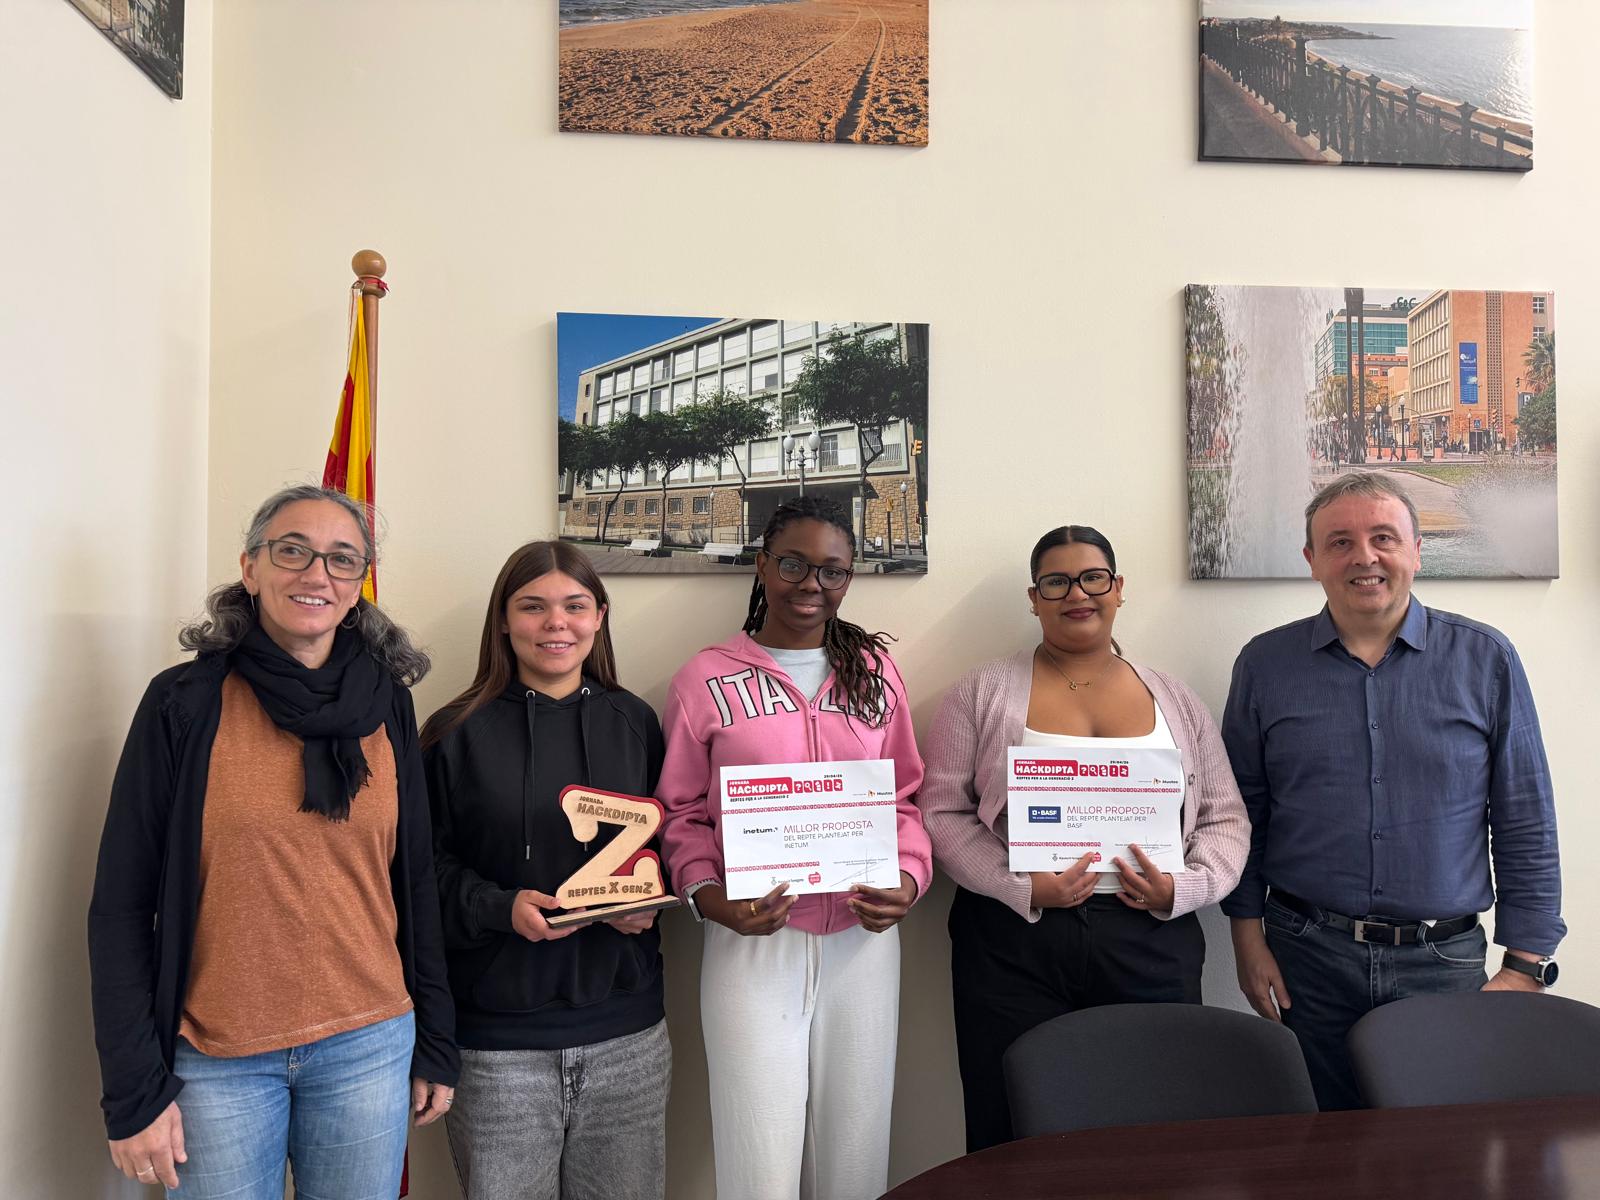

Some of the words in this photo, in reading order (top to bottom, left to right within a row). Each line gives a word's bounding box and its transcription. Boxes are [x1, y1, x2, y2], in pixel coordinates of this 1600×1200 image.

[1016, 765, 1074, 774] HACKDIPTA
[729, 783, 789, 795] HACKDIPTA
[577, 802, 648, 824] HACKDIPTA
[1067, 806, 1102, 815] MILLOR
[1105, 806, 1157, 815] PROPOSTA
[783, 823, 819, 834] MILLOR
[822, 820, 874, 831] PROPOSTA
[817, 831, 850, 840] PLANTEJAT
[568, 886, 606, 898] REPTES
[609, 881, 619, 894] X
